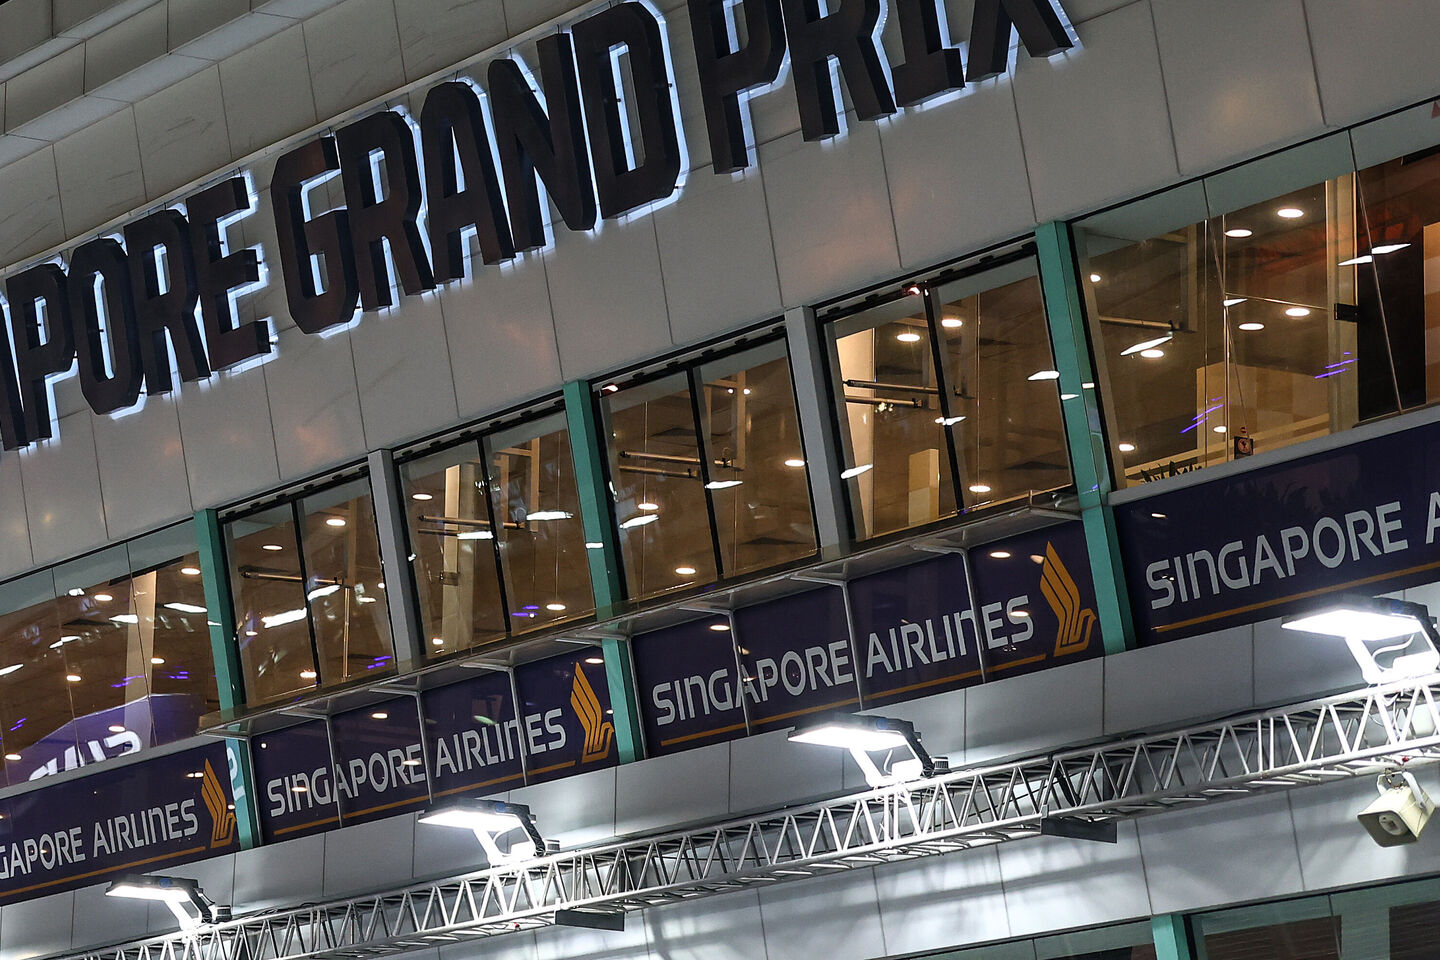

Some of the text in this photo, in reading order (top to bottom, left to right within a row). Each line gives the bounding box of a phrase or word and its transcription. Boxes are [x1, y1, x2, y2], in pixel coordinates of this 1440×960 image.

[270, 0, 681, 335] GRAND
[1146, 501, 1408, 610] SINGAPORE
[652, 594, 1034, 726] SINGAPORE AIRLINES
[267, 743, 427, 817] SINGAPORE
[435, 708, 567, 778] AIRLINES
[93, 798, 199, 857] AIRLINES
